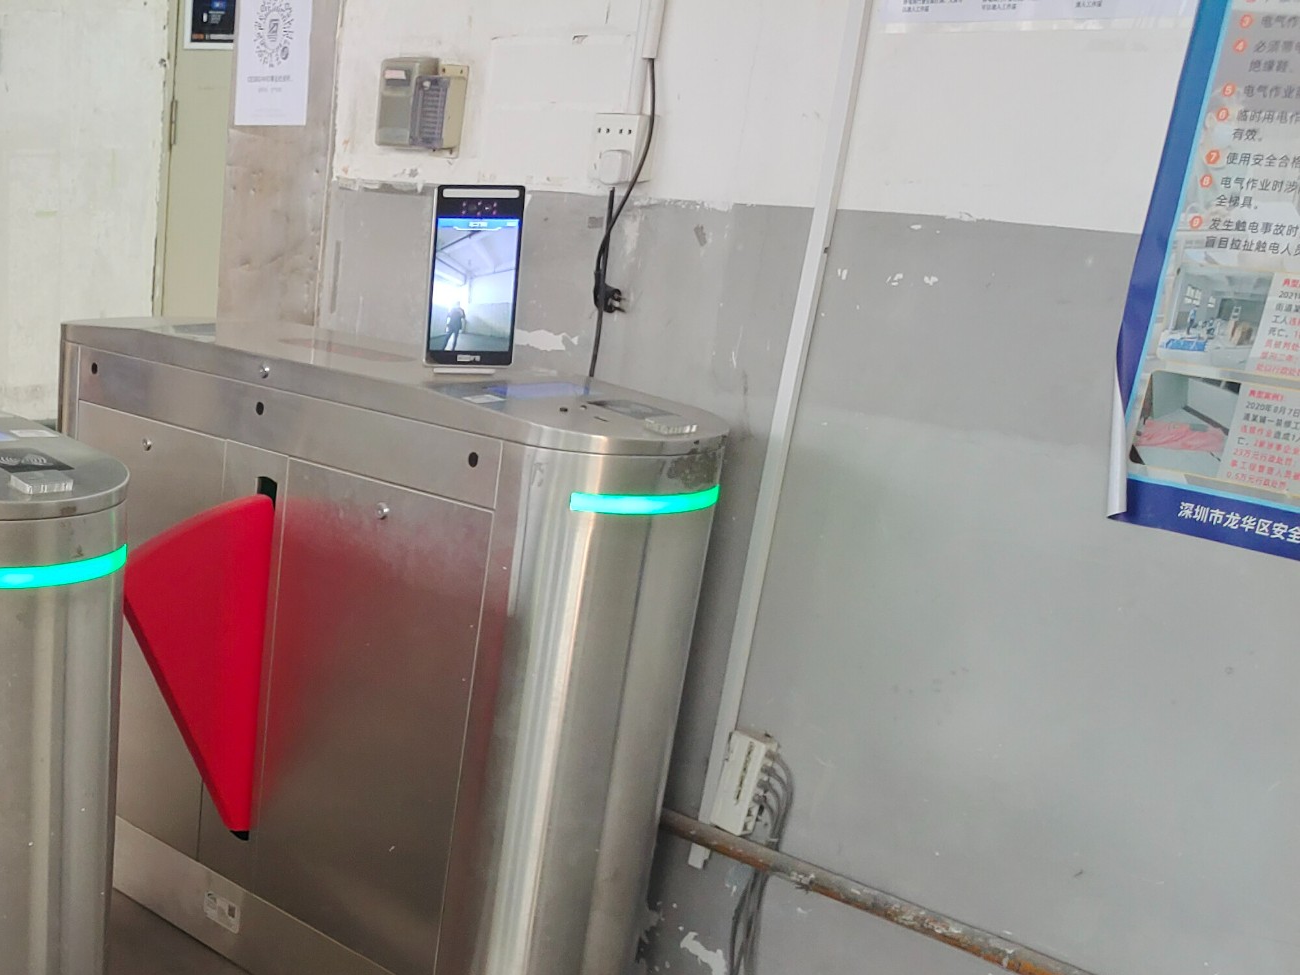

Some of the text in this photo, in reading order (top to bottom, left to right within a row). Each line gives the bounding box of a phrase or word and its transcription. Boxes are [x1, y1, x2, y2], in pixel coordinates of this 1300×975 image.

[1177, 501, 1300, 544] 深圳市龙华区安全
